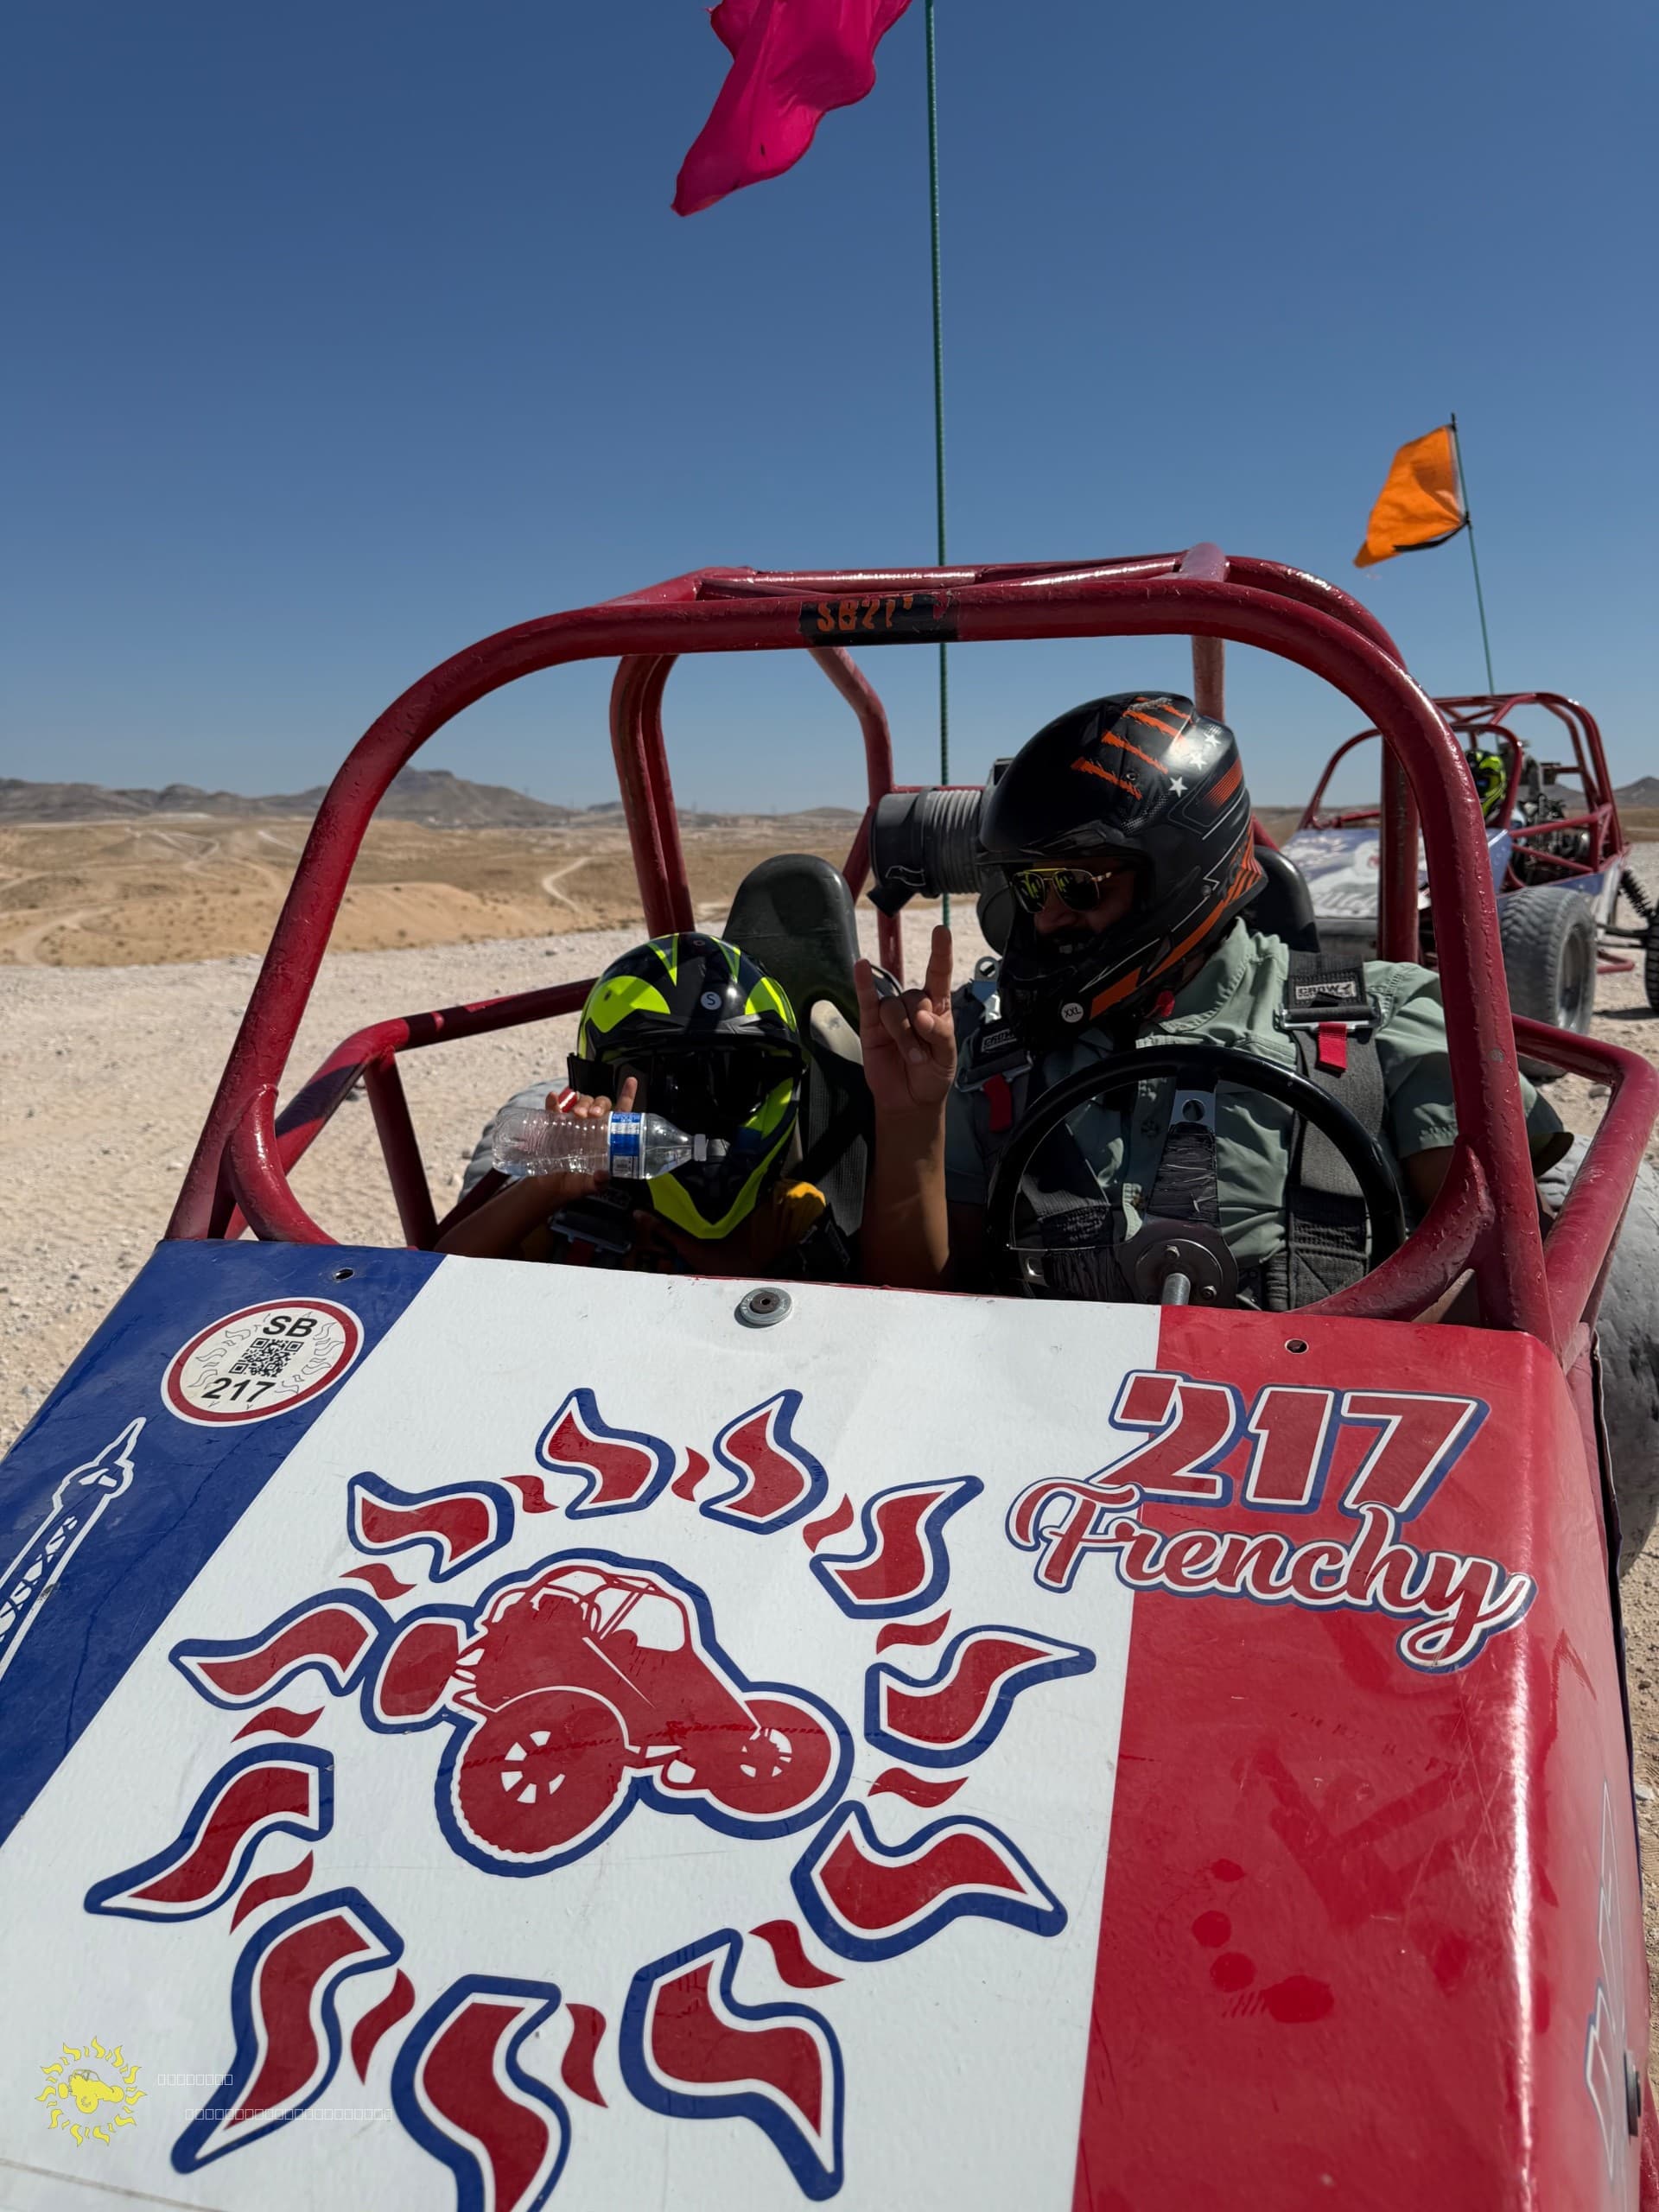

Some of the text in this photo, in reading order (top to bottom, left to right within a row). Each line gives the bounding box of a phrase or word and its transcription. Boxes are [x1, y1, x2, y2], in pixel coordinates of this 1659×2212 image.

[707, 994, 716, 1006] S
[1064, 1006, 1082, 1019] XXL
[263, 1315, 318, 1338] SB
[201, 1377, 277, 1403] 217
[1090, 1370, 1490, 1522] 217
[1006, 1478, 1537, 1674] Frenchy
